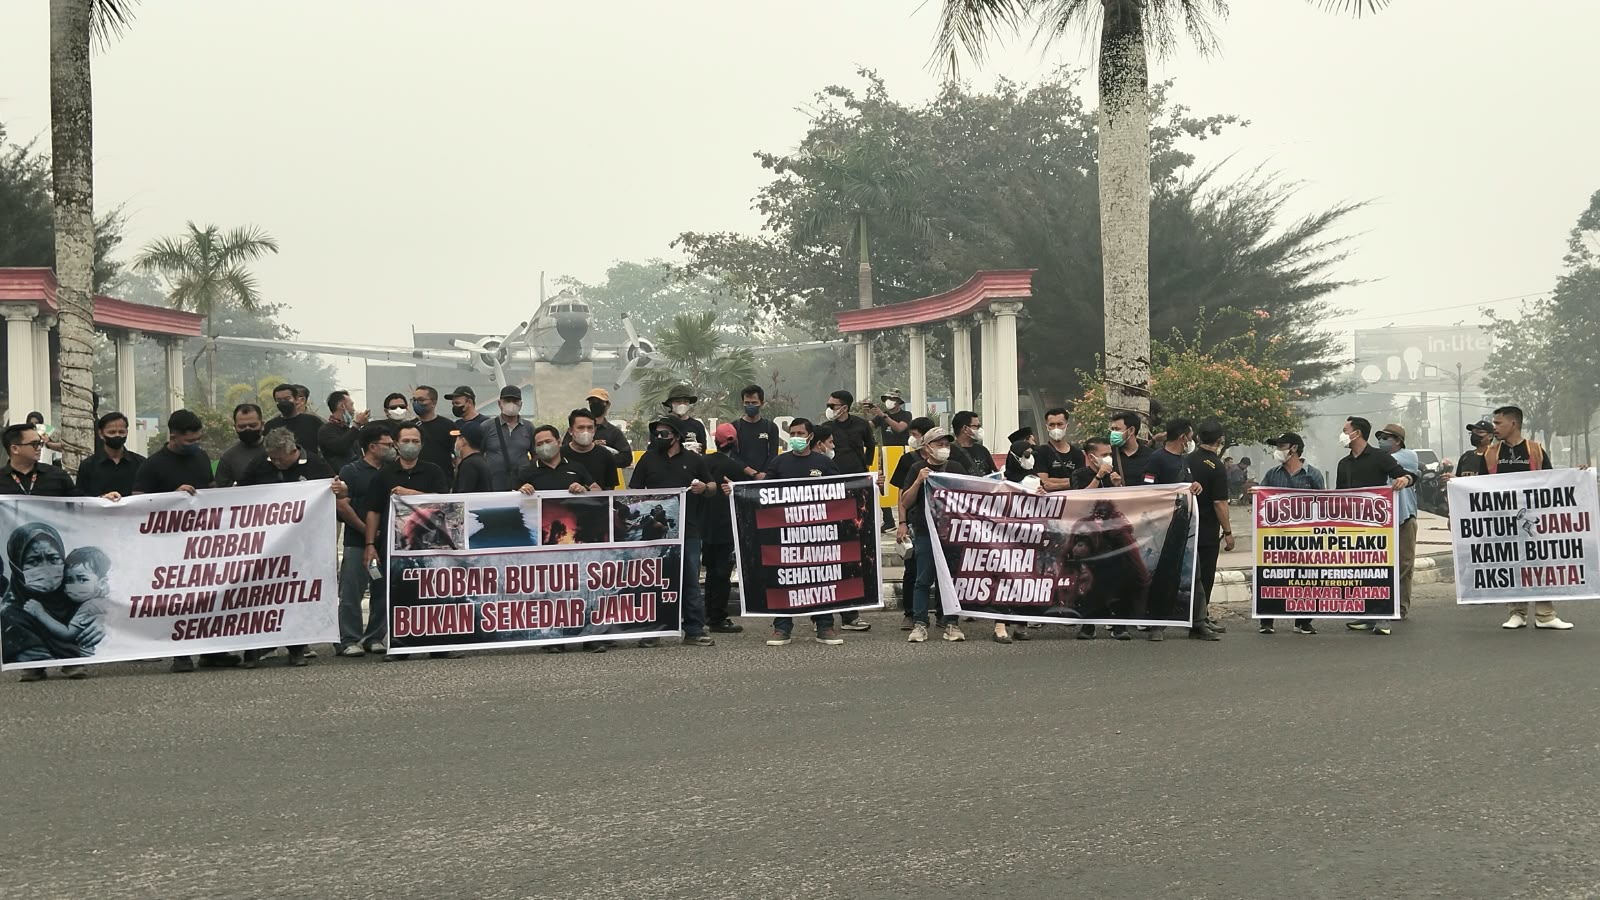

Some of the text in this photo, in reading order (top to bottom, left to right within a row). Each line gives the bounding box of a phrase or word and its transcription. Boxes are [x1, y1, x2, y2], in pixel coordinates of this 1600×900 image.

[759, 482, 846, 505] SELAMATKAN
[1469, 486, 1577, 512] KAMI TIDAK
[139, 500, 306, 534] JANGAN TUNGGU
[784, 503, 827, 523] HUTAN
[1010, 495, 1064, 517] KAMI
[1265, 495, 1388, 524] USUT TUNTAS
[780, 524, 839, 544] LINDUNGI
[949, 519, 1050, 546] TERBAKAR,
[1313, 527, 1335, 535] DAN
[1460, 512, 1590, 538] BUTUH JANJI
[183, 531, 266, 560] KORBAN
[780, 544, 841, 563] RELAWAN
[1263, 535, 1387, 550] HUKUM PELAKU
[1471, 538, 1584, 563] KAMI BUTUH
[961, 548, 1035, 572] NEGARA
[1263, 551, 1388, 564] PEMBAKARAN HUTAN
[151, 555, 298, 589] SELANJUTNYA,
[505, 562, 579, 594] BUTUH
[587, 557, 670, 590] SOLUSI,
[777, 564, 842, 585] SEHATKAN
[1262, 568, 1388, 579] CABUT IJIN PERUSAHAAN
[1474, 564, 1585, 589] AKSI NYATA!
[129, 579, 322, 618] TANGANI KARHUTLA
[788, 585, 837, 607] RAKYAT
[952, 577, 992, 601] RUS
[1261, 586, 1390, 599] MEMBAKAR LAHAN
[1286, 599, 1365, 612] DAN HUTAN
[171, 609, 285, 641] SEKARANG!
[393, 603, 474, 638] BUKAN
[480, 598, 585, 633] SEKEDAR
